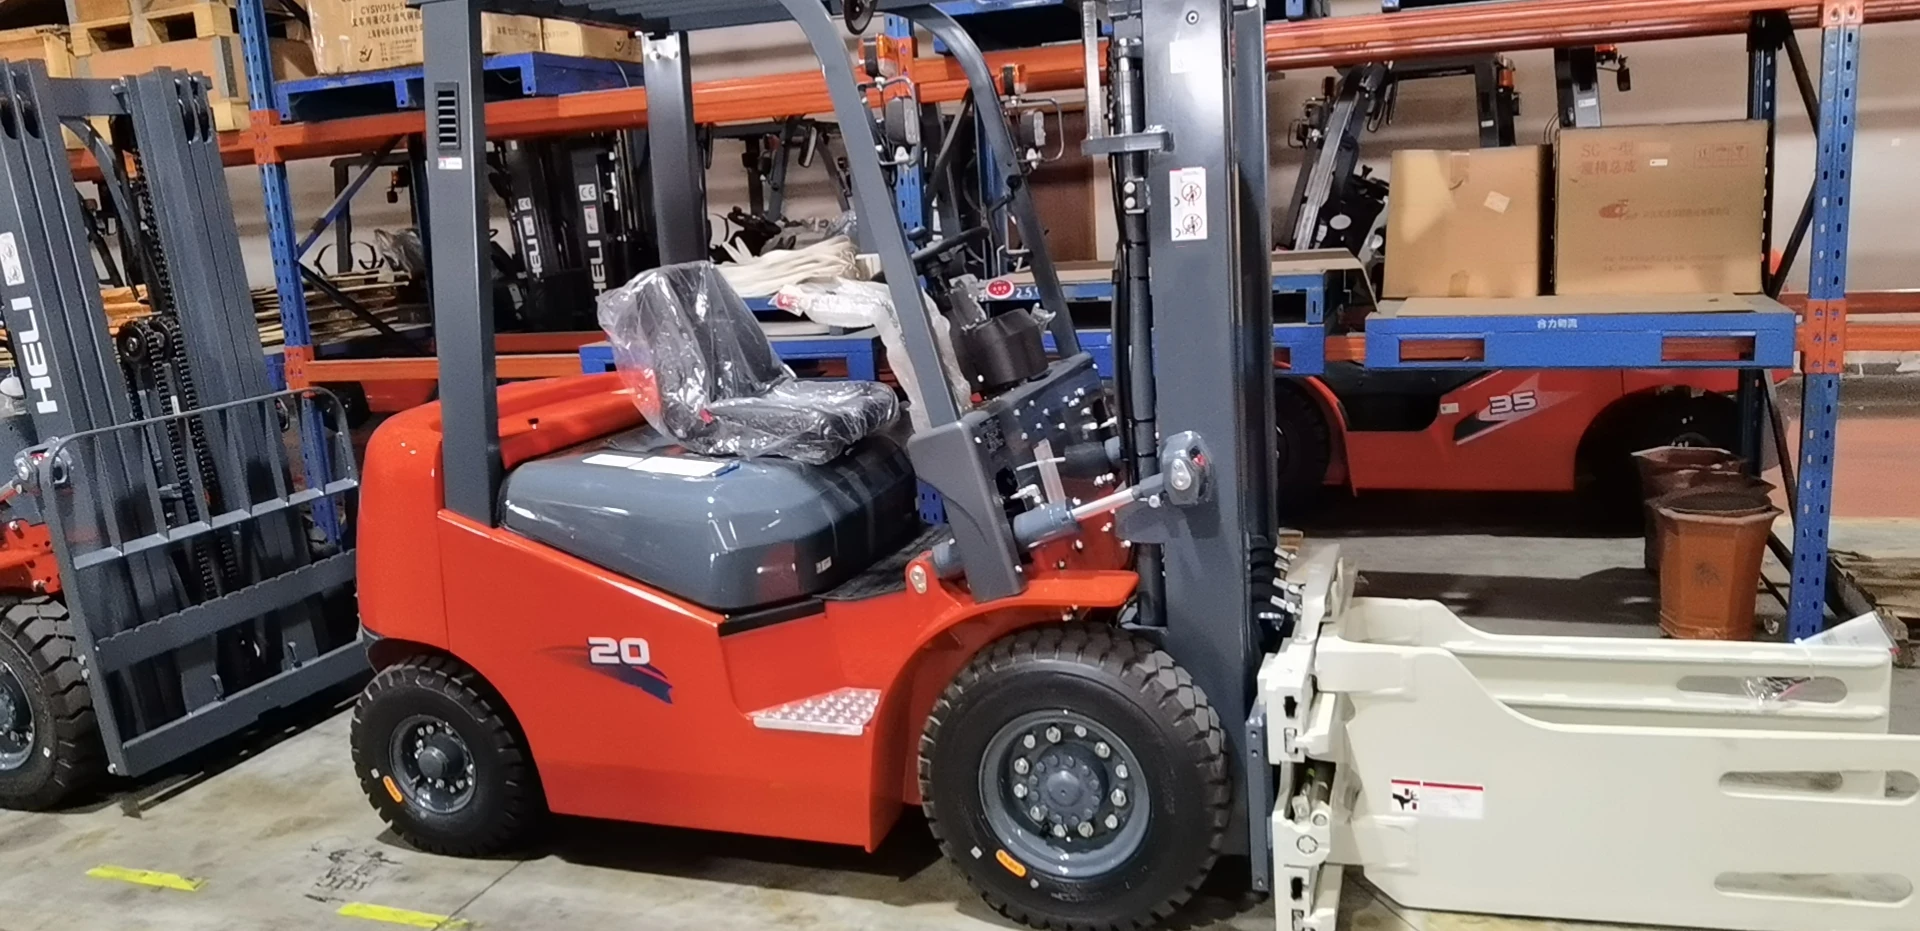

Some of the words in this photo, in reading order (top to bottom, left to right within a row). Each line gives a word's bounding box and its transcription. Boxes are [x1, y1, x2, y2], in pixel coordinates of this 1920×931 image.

[11, 296, 58, 414] HELI
[1489, 391, 1537, 415] 35
[587, 636, 650, 665] 20
